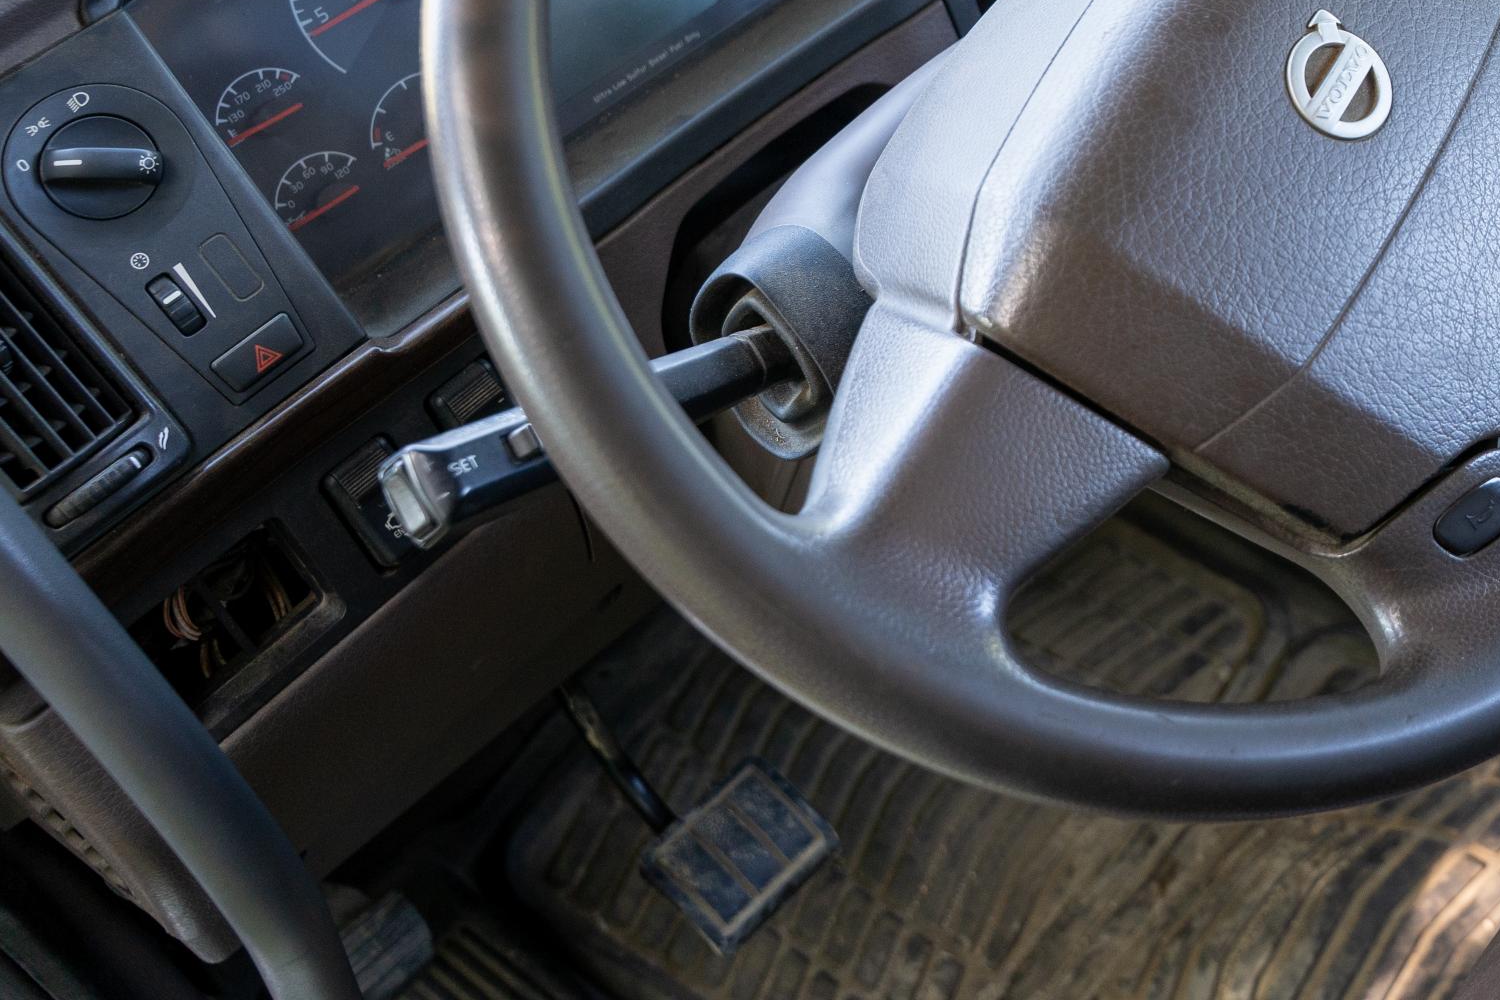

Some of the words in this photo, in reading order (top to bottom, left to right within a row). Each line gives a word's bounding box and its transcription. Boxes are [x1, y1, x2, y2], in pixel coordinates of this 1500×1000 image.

[313, 6, 329, 24] 5
[255, 79, 273, 93] 210
[272, 81, 292, 97] 250
[1315, 44, 1368, 120] VOLVO
[234, 91, 251, 105] 170
[228, 110, 245, 124] 130
[302, 167, 316, 180] 60
[320, 162, 334, 175] 90
[333, 166, 351, 180] 120
[290, 181, 304, 194] 30
[447, 455, 480, 476] SET
